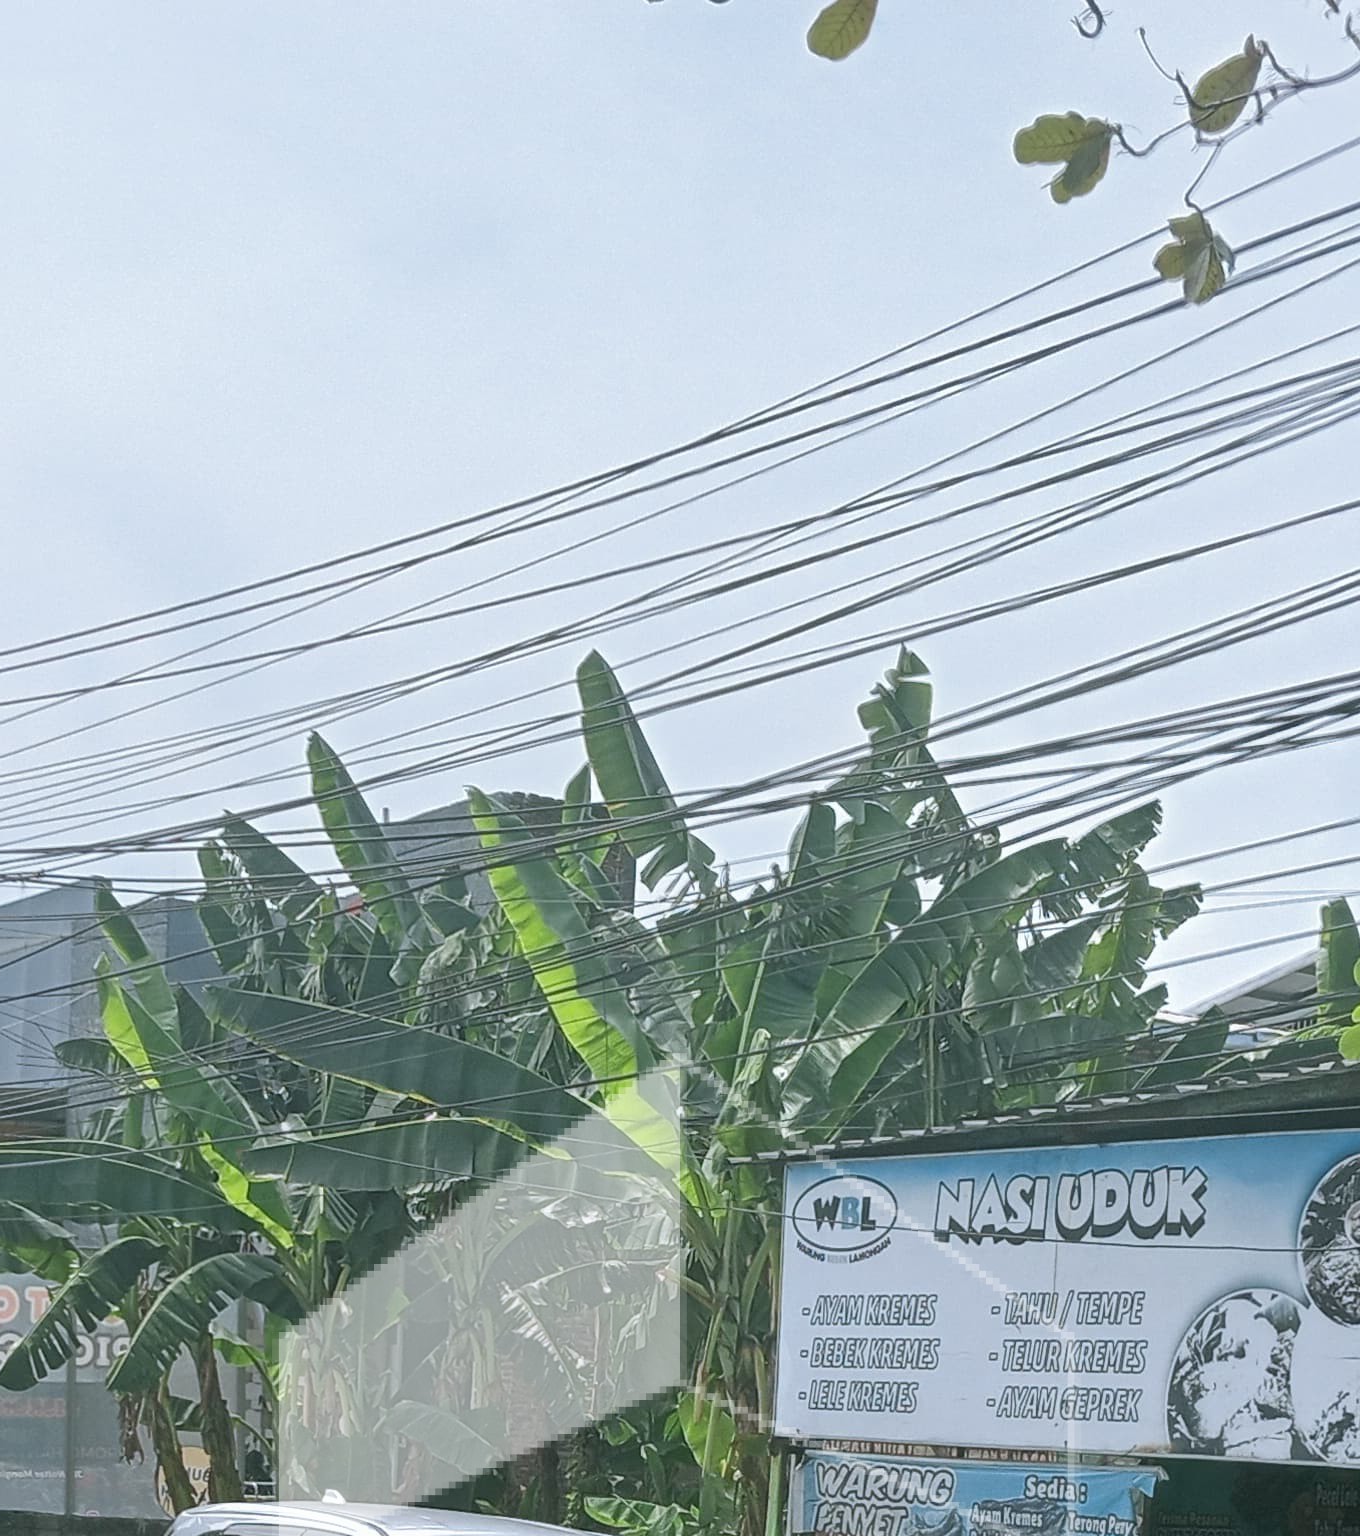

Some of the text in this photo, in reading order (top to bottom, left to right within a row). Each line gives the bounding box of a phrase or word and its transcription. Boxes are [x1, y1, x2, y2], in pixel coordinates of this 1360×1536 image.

[813, 1195, 877, 1232] WBL
[935, 1166, 1208, 1245] NASI UDUK
[810, 1295, 938, 1326] AYAM KREMES
[1004, 1292, 1059, 1326] TAHU
[1077, 1291, 1146, 1325] TEMPE
[810, 1338, 941, 1370] BEBEK KREMES
[1002, 1340, 1148, 1373] TELUR KREMES
[808, 1380, 919, 1413] LELE KREMES
[996, 1386, 1143, 1422] AYAM GEPREK
[816, 1463, 955, 1506] WARUNG
[971, 1504, 1044, 1529] Ayam Kremes
